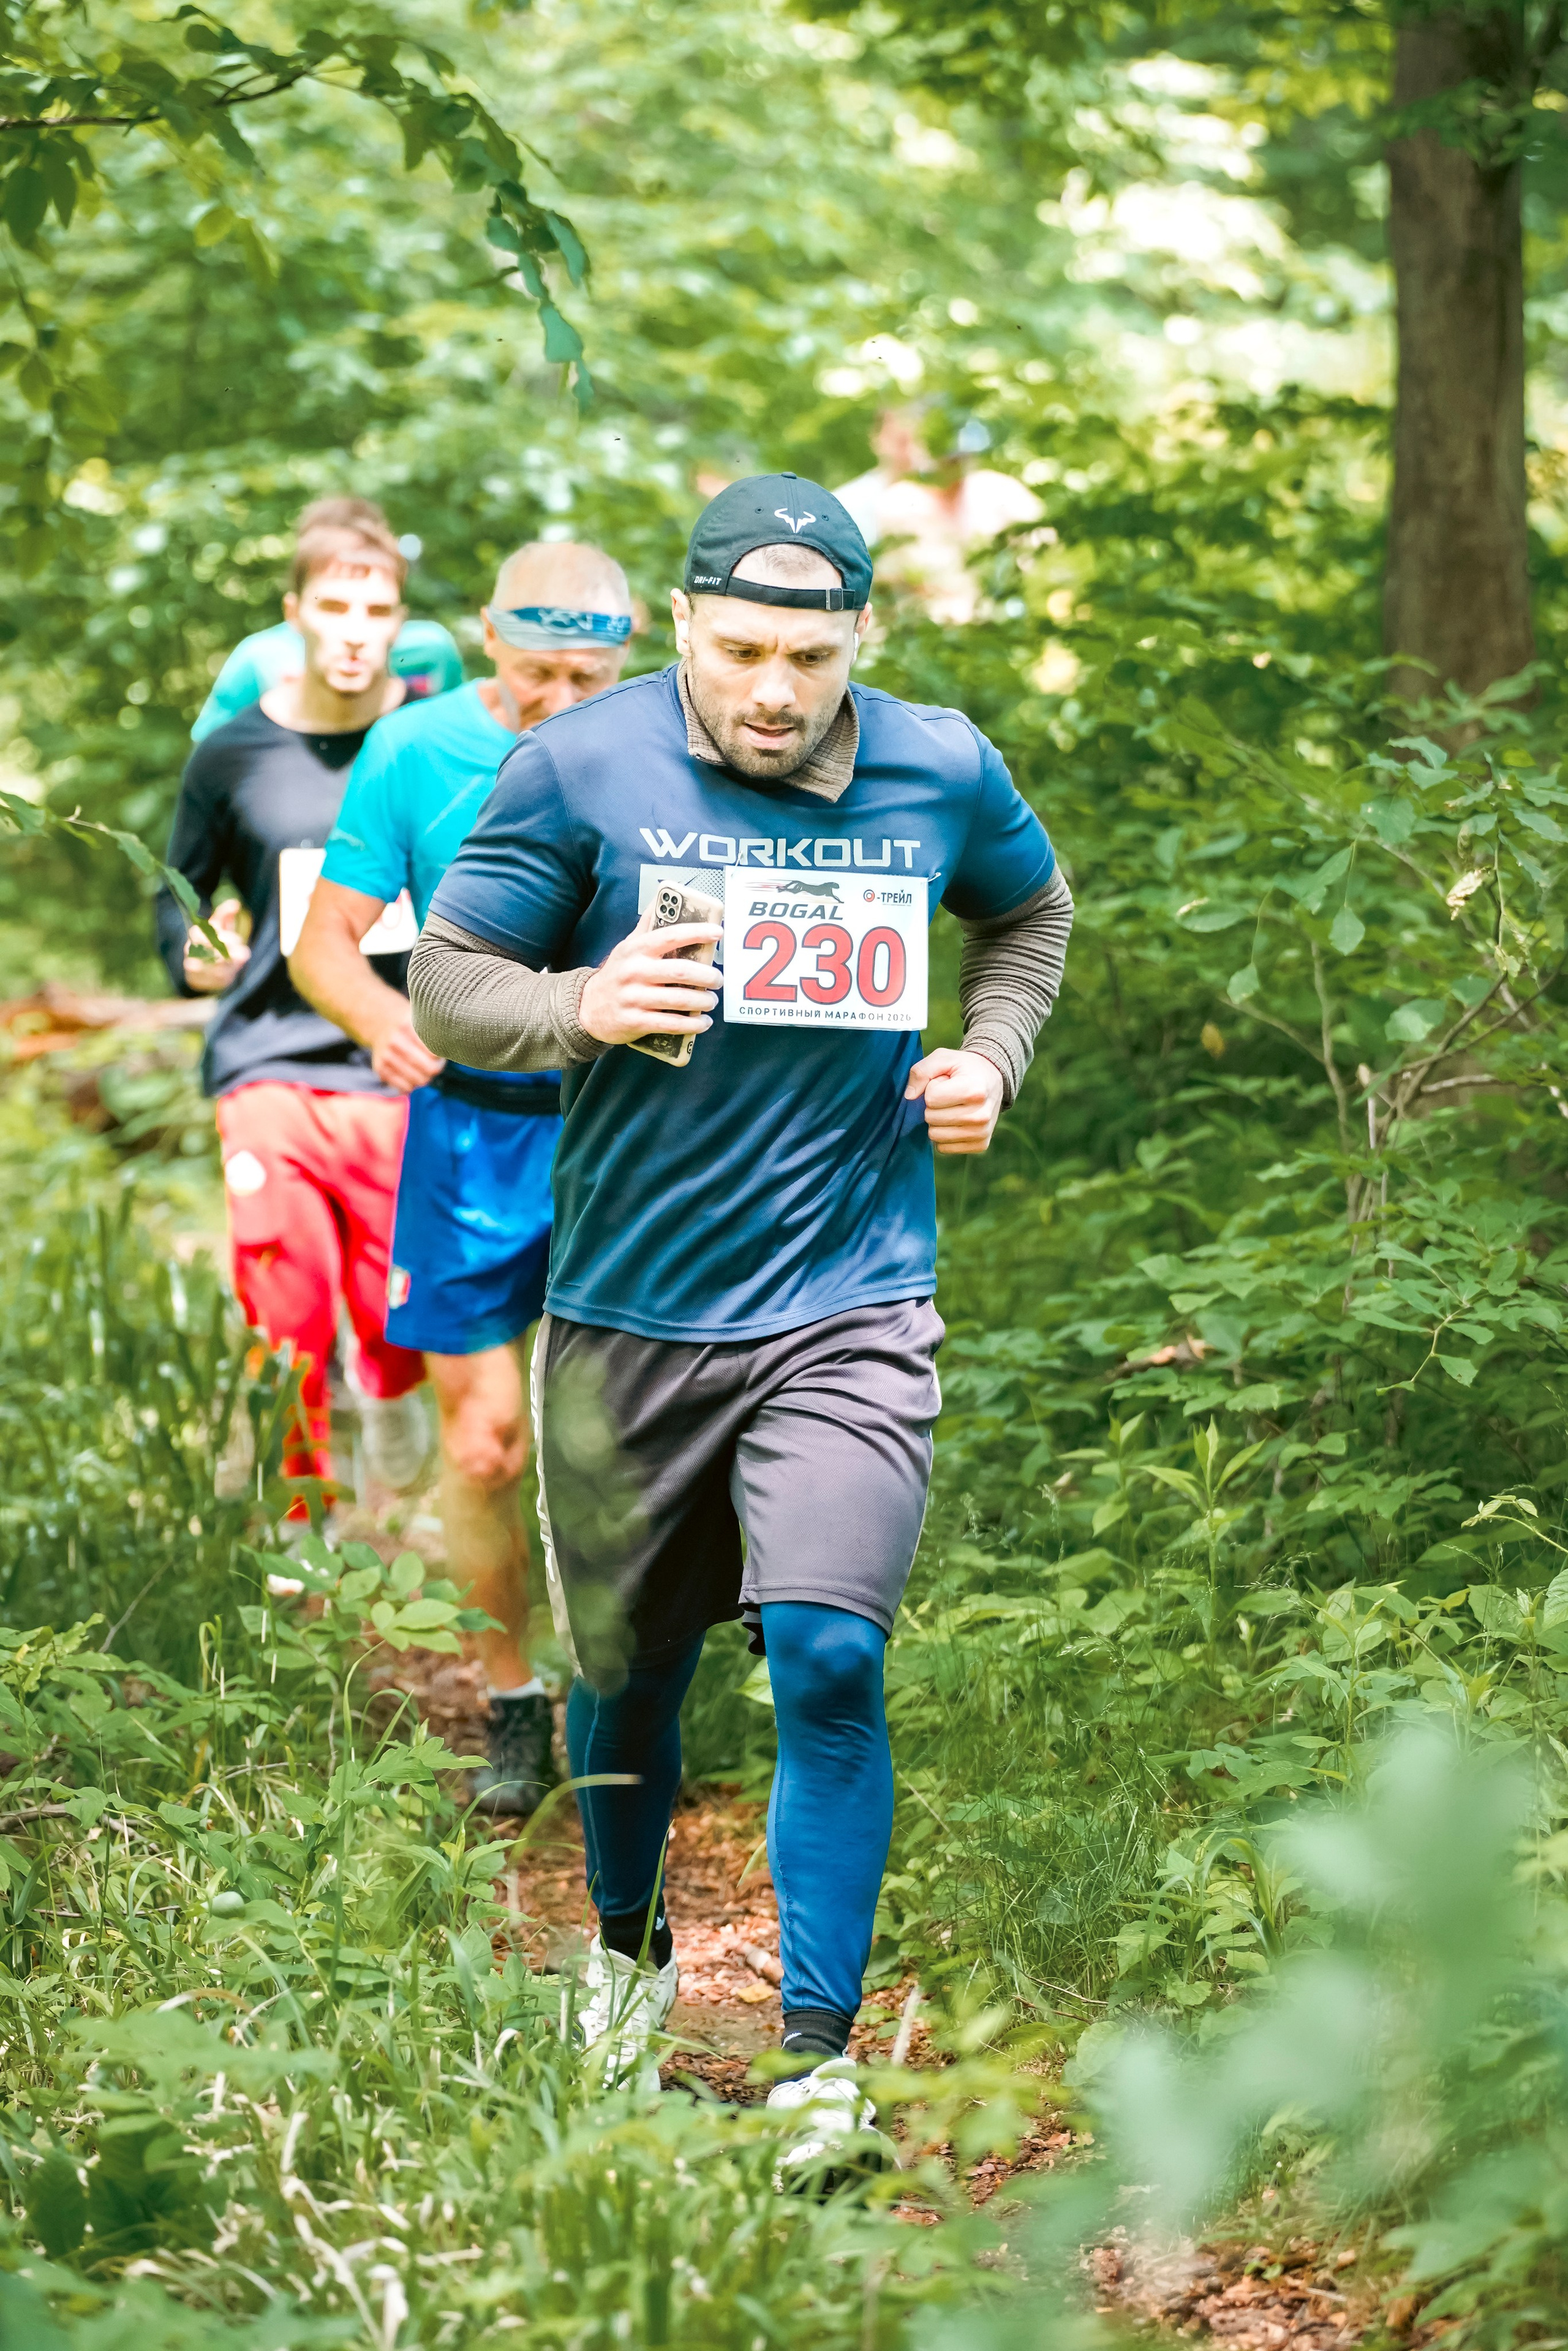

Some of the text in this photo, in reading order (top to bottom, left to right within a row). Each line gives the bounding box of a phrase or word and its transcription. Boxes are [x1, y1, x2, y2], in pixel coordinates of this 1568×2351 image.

[694, 576, 722, 585] DRI-FIT
[639, 828, 921, 868] WORKOUT
[748, 902, 843, 920] BOGAL
[743, 921, 907, 1007] 230
[739, 1006, 821, 1018] СПОРТИВНЫЙ
[824, 1011, 883, 1021] МАРАФОН
